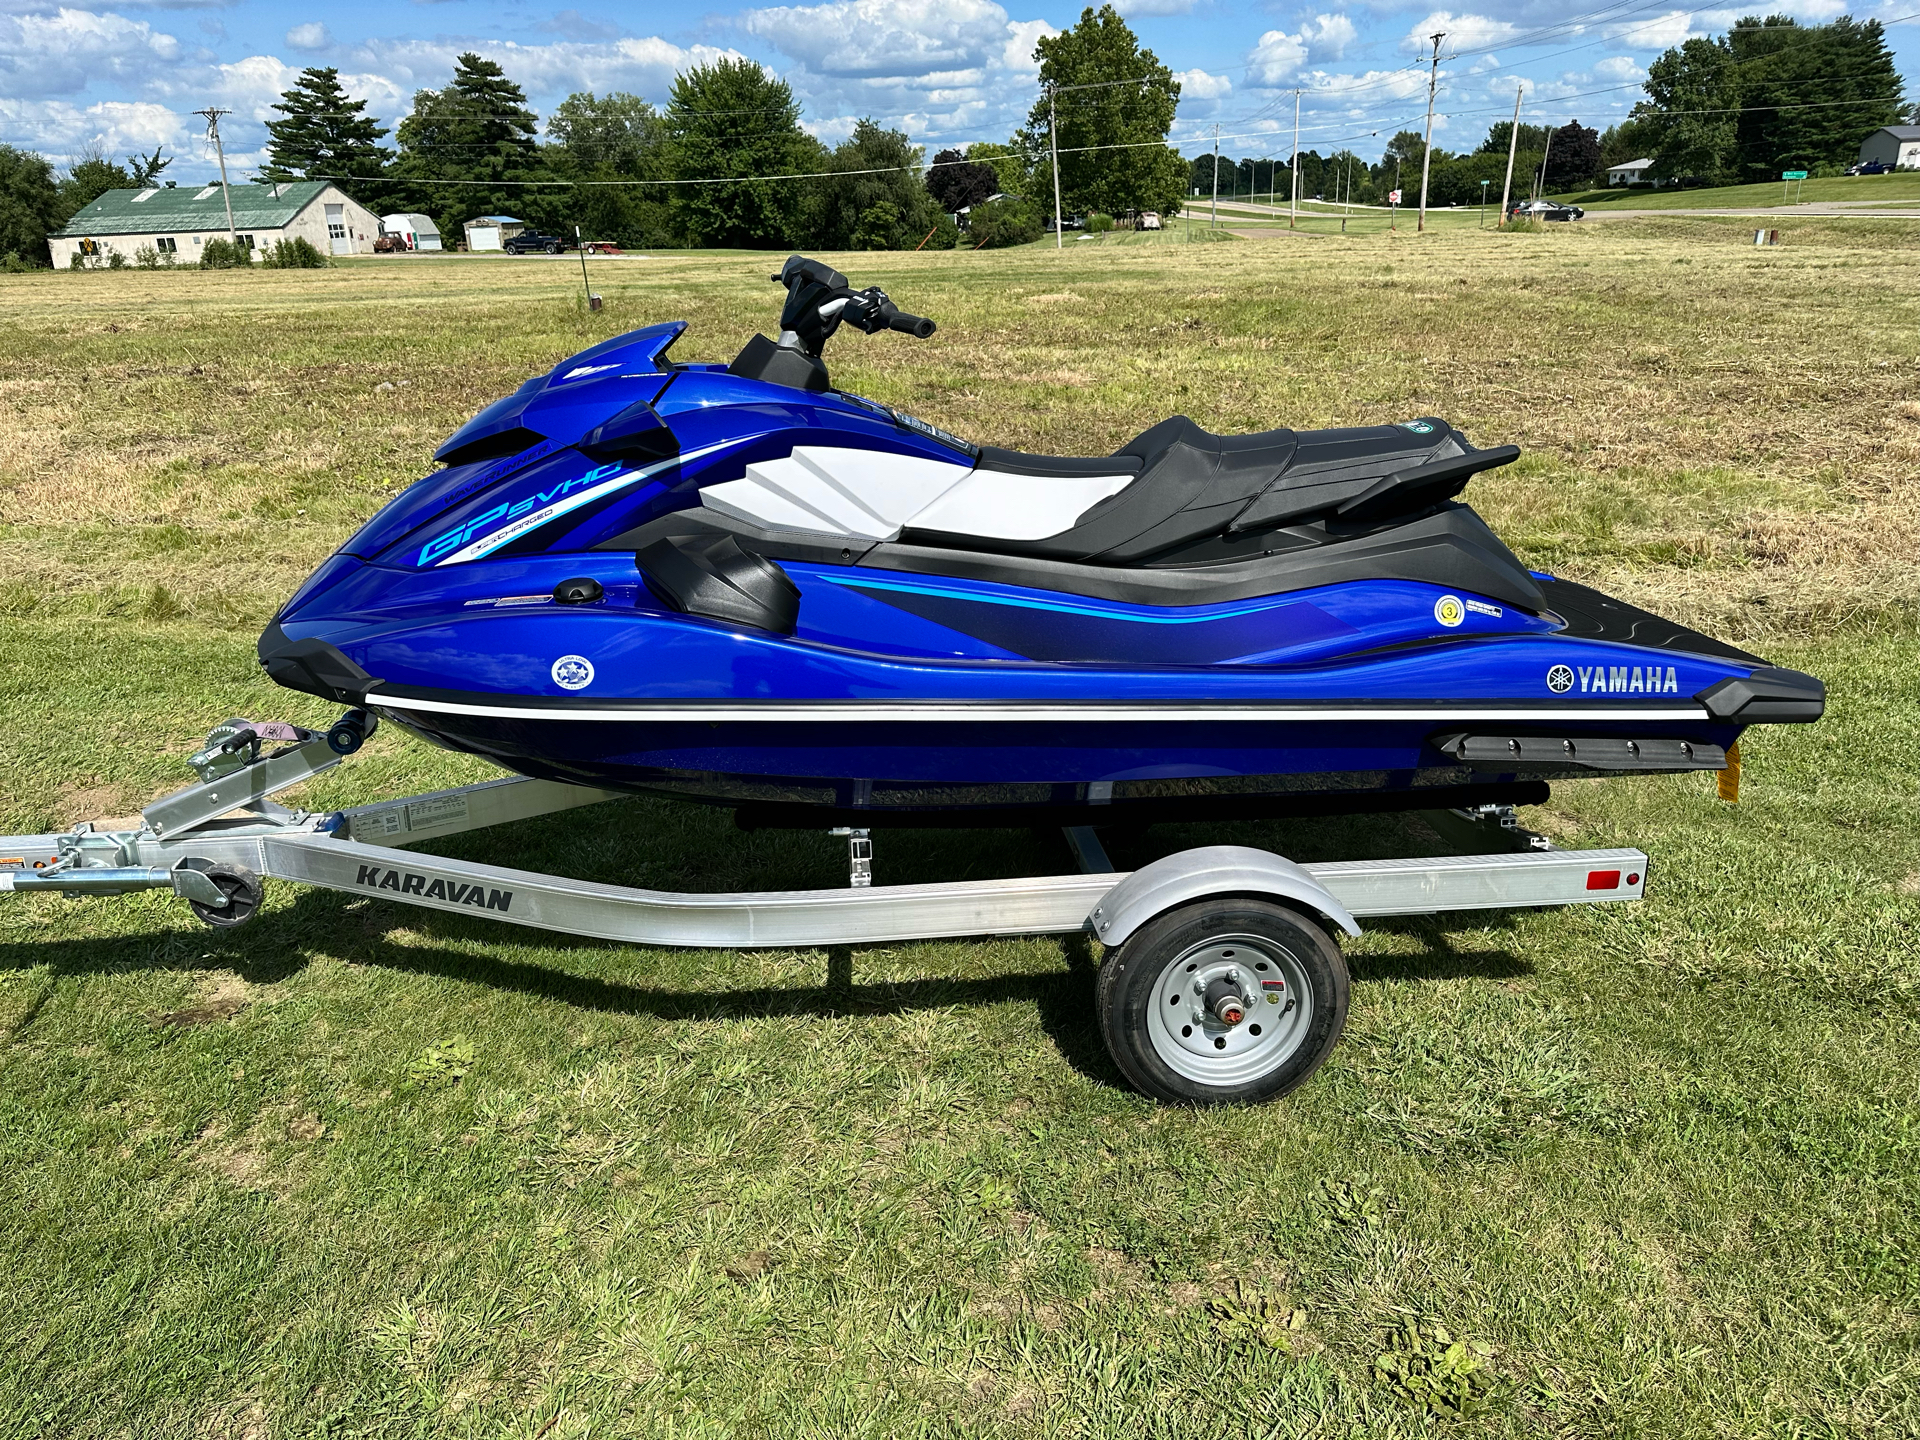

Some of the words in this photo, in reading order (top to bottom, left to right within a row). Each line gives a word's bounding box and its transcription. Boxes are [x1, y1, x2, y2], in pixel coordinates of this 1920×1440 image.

[444, 445, 548, 504] WAVERUNNER
[417, 502, 510, 567] GP
[507, 459, 624, 520] SVHO
[470, 509, 553, 555] CHARGED
[1446, 607, 1453, 616] 3
[1577, 666, 1678, 693] YAMAHA
[356, 865, 513, 912] KARAVAN
